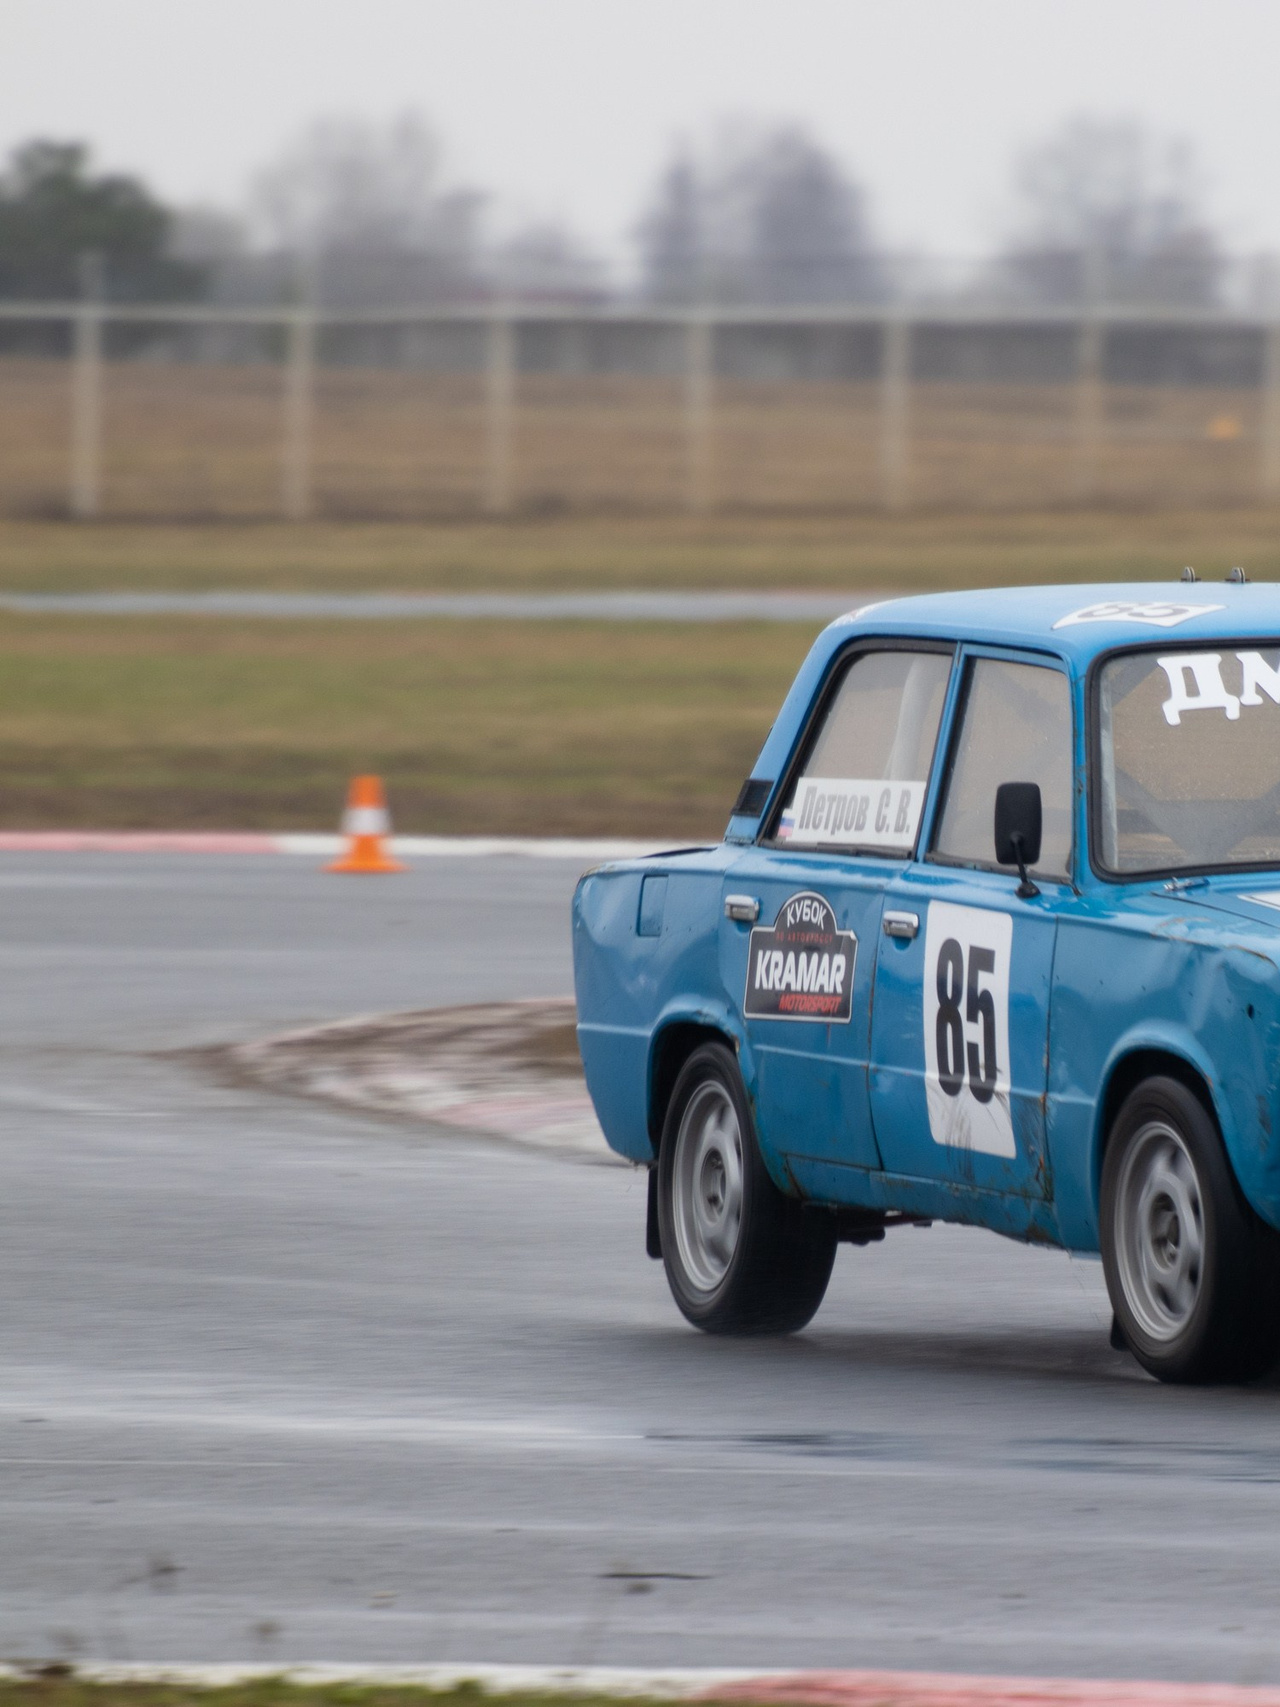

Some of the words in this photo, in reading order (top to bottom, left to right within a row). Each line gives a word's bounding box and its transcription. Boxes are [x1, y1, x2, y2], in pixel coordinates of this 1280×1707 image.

[798, 786, 870, 836] Петров
[874, 787, 891, 833] С.
[893, 788, 912, 833] В.
[786, 899, 827, 930] КУБОК
[755, 949, 846, 994] KRAMAR
[778, 994, 842, 1013] MOTORSPORT
[936, 937, 997, 1103] 85
